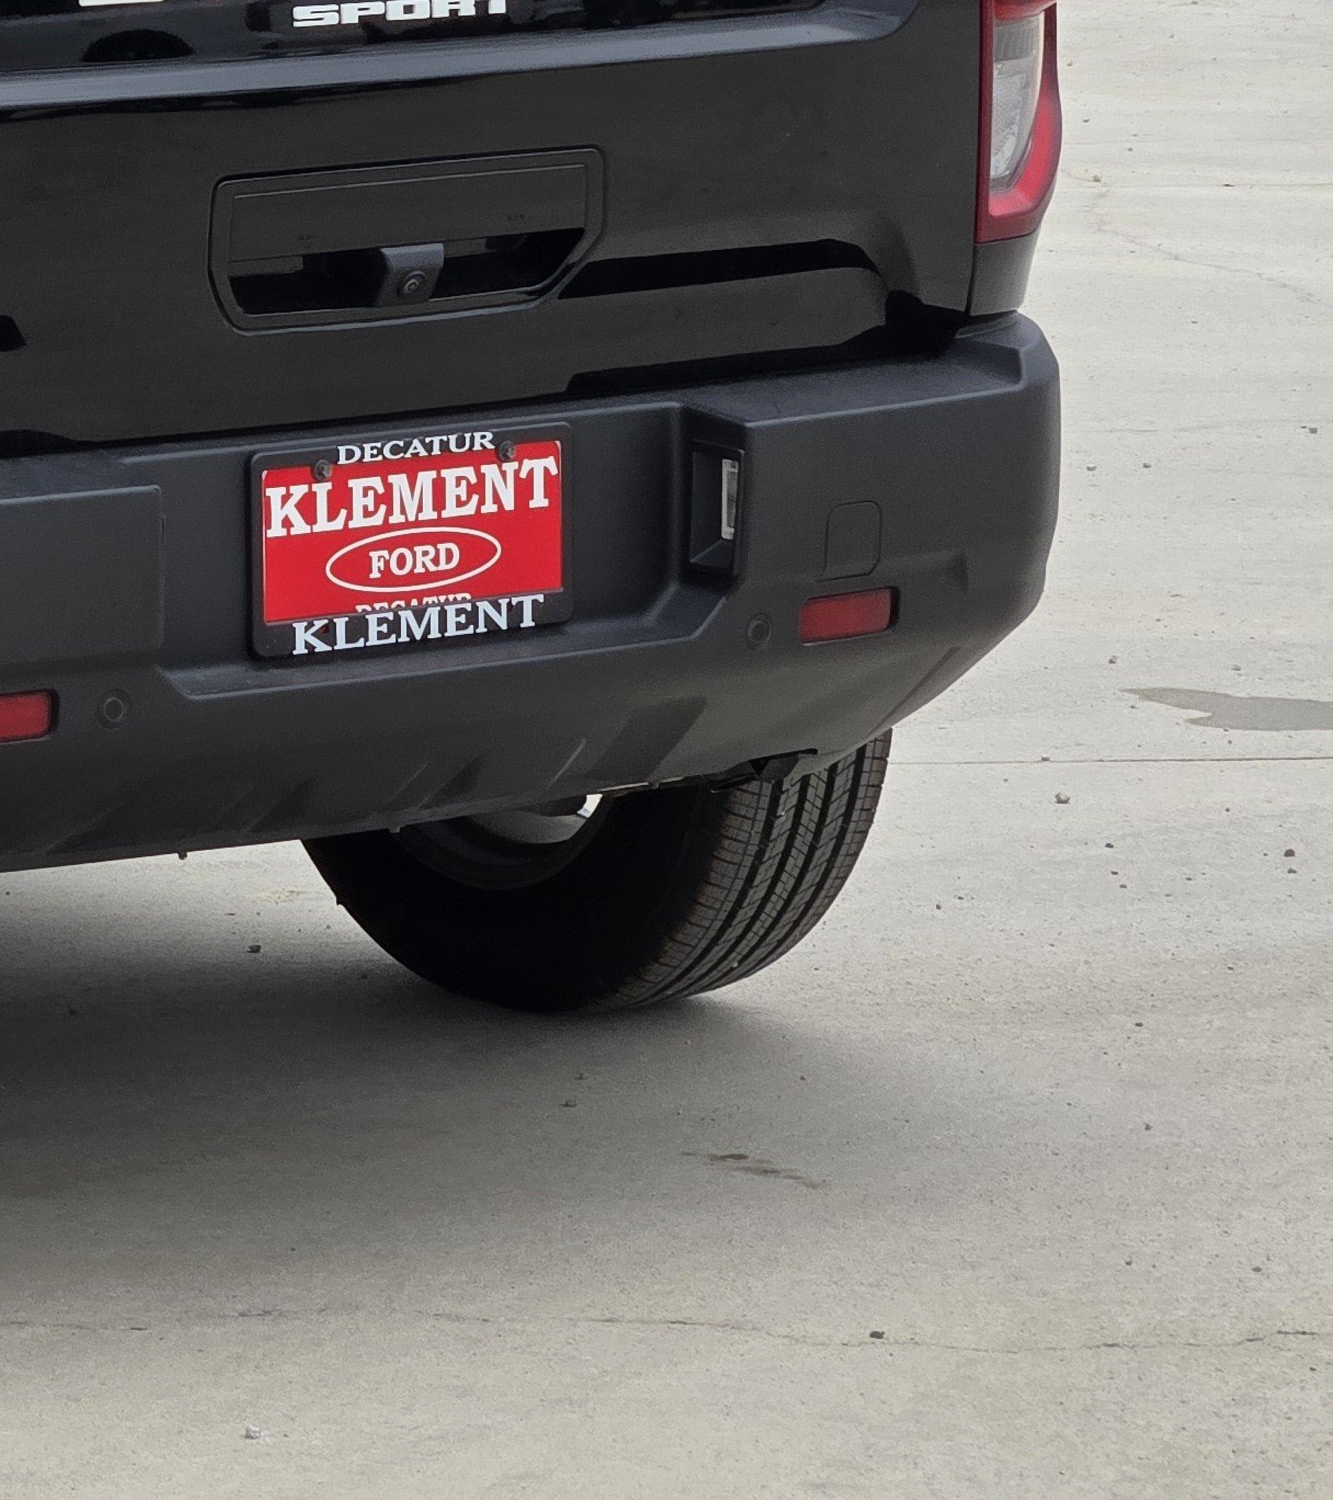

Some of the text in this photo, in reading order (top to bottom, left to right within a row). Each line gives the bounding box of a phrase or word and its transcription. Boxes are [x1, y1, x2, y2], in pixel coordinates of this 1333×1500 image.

[337, 431, 496, 465] DECATUR
[265, 455, 559, 538] KLEMENT
[368, 542, 461, 580] FORD
[291, 594, 545, 656] KLEMENT
